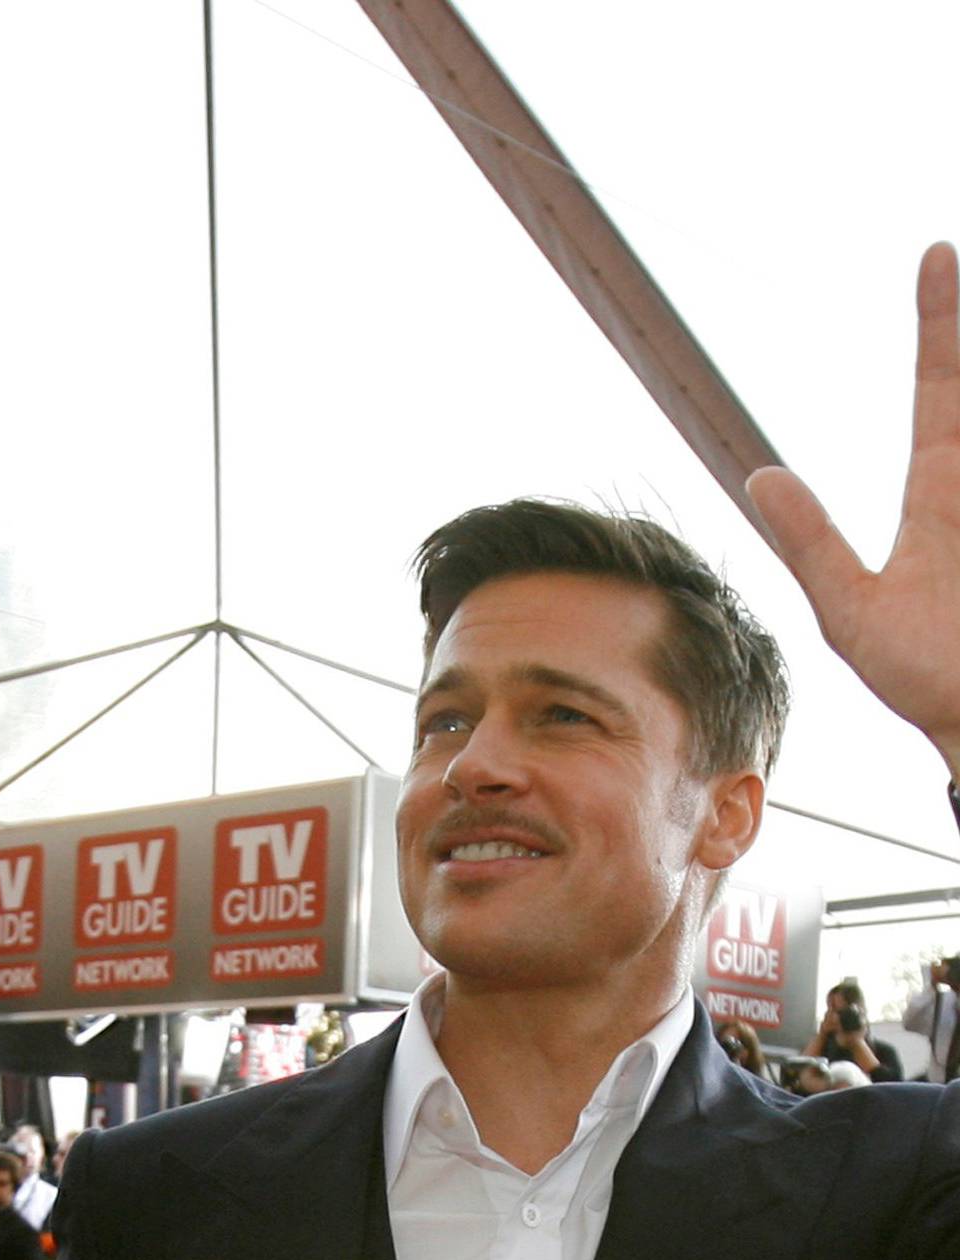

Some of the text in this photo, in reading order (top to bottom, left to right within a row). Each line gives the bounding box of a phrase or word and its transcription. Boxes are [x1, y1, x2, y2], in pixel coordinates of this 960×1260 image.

[92, 838, 165, 899] TV
[231, 819, 314, 884] TV
[82, 897, 168, 938] GUIDE
[221, 881, 316, 926] GUIDE
[76, 955, 169, 984] NETWORK
[213, 944, 319, 975] NETWORK
[714, 939, 779, 981] GUIDE
[708, 991, 779, 1023] NETWORK
